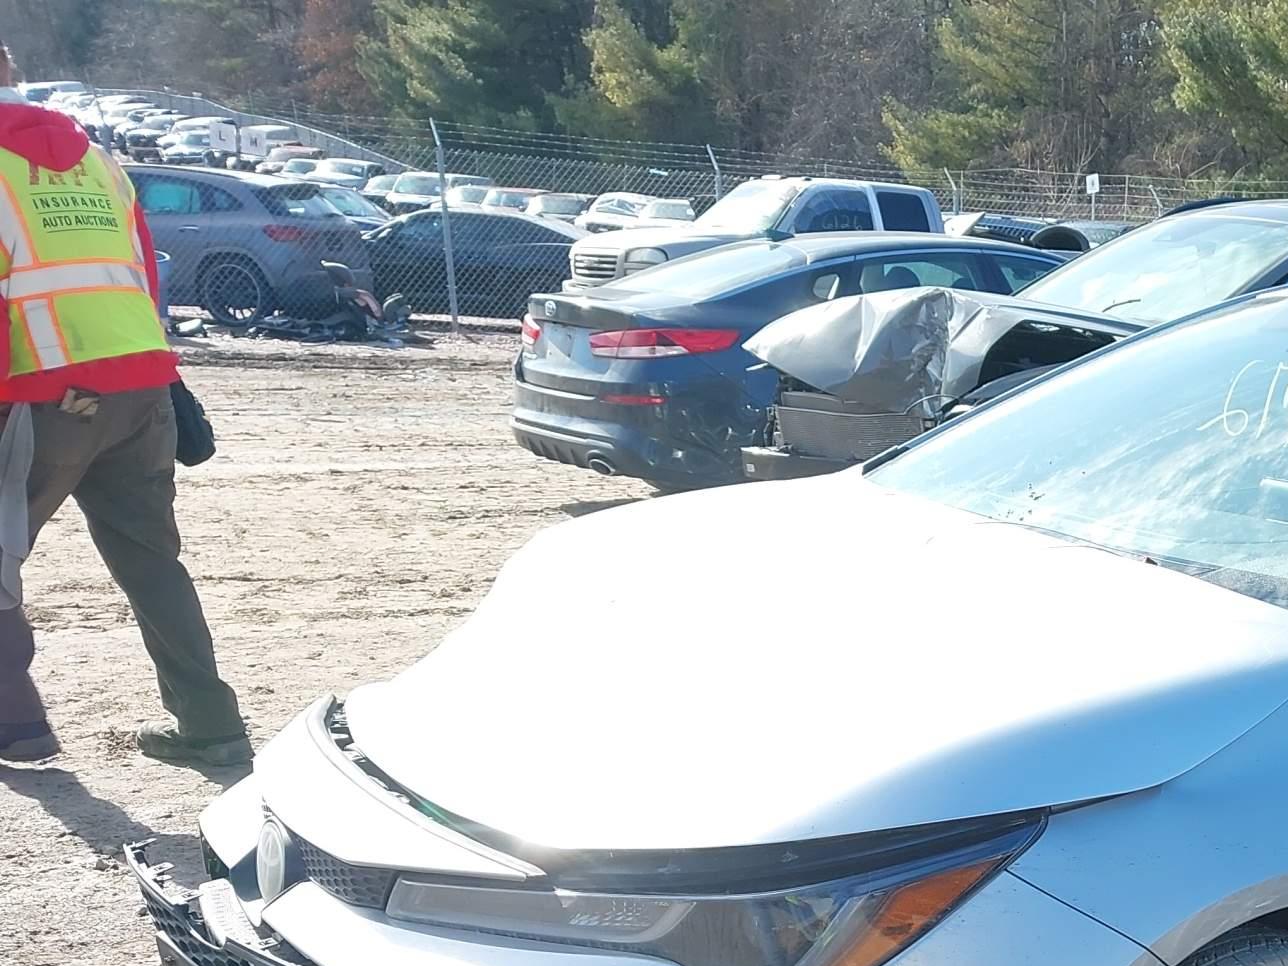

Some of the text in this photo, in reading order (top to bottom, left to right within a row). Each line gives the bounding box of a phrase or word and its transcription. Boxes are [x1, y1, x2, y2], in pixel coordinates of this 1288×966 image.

[32, 197, 113, 210] INSURANCE
[42, 214, 119, 229] AUTO AUCTIONS
